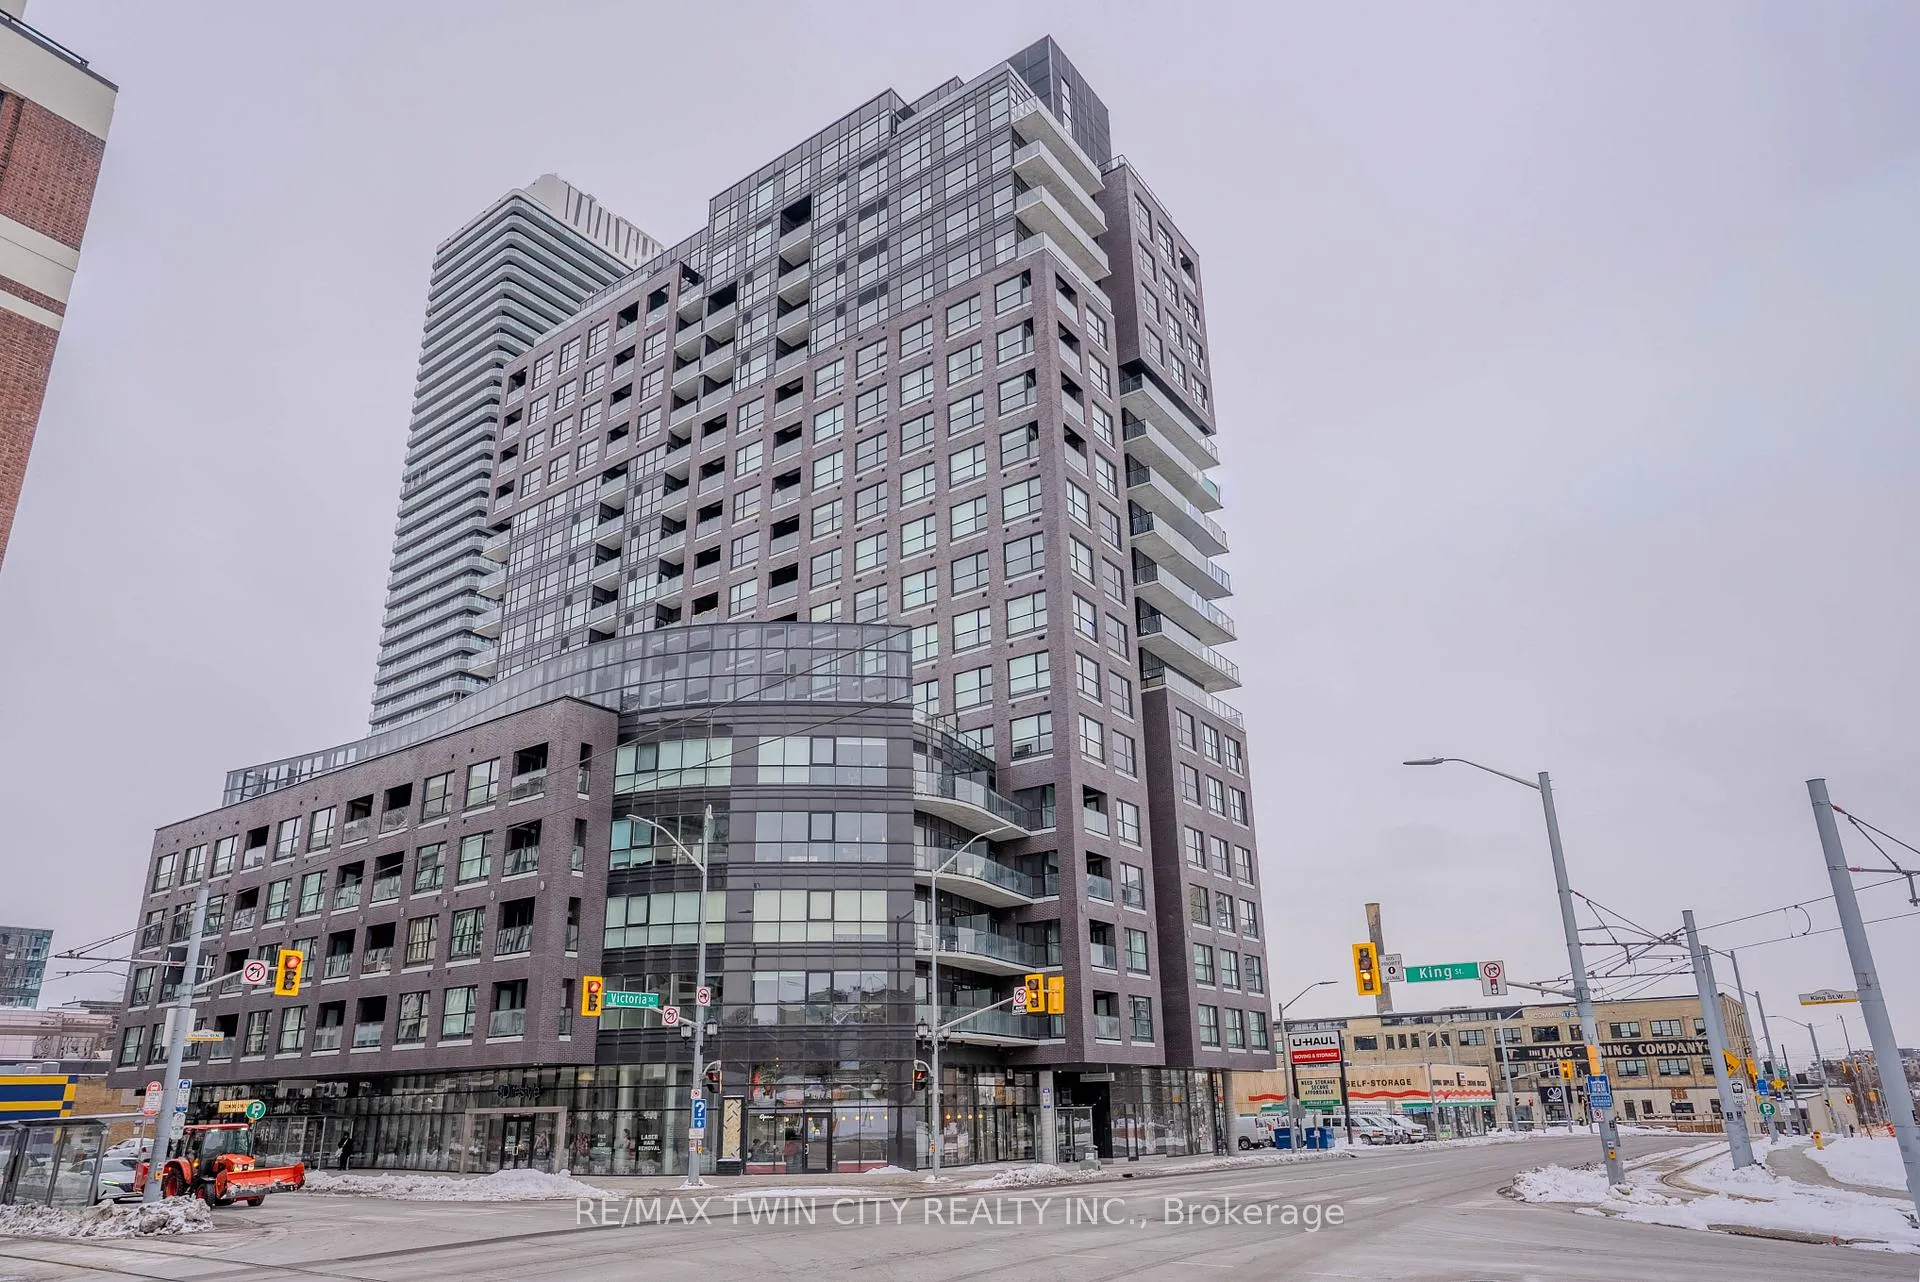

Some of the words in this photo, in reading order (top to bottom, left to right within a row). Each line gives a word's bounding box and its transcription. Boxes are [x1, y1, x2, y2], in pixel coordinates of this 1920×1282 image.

[1420, 965, 1452, 980] King
[610, 993, 647, 1004] Victoria
[1533, 1010, 1578, 1019] COMMUNITEC
[1293, 1036, 1336, 1046] U-HAUL
[1541, 1046, 1573, 1059] LANG
[1638, 1041, 1704, 1055] COMPANY
[1345, 1078, 1412, 1088] SELF-STORAGE
